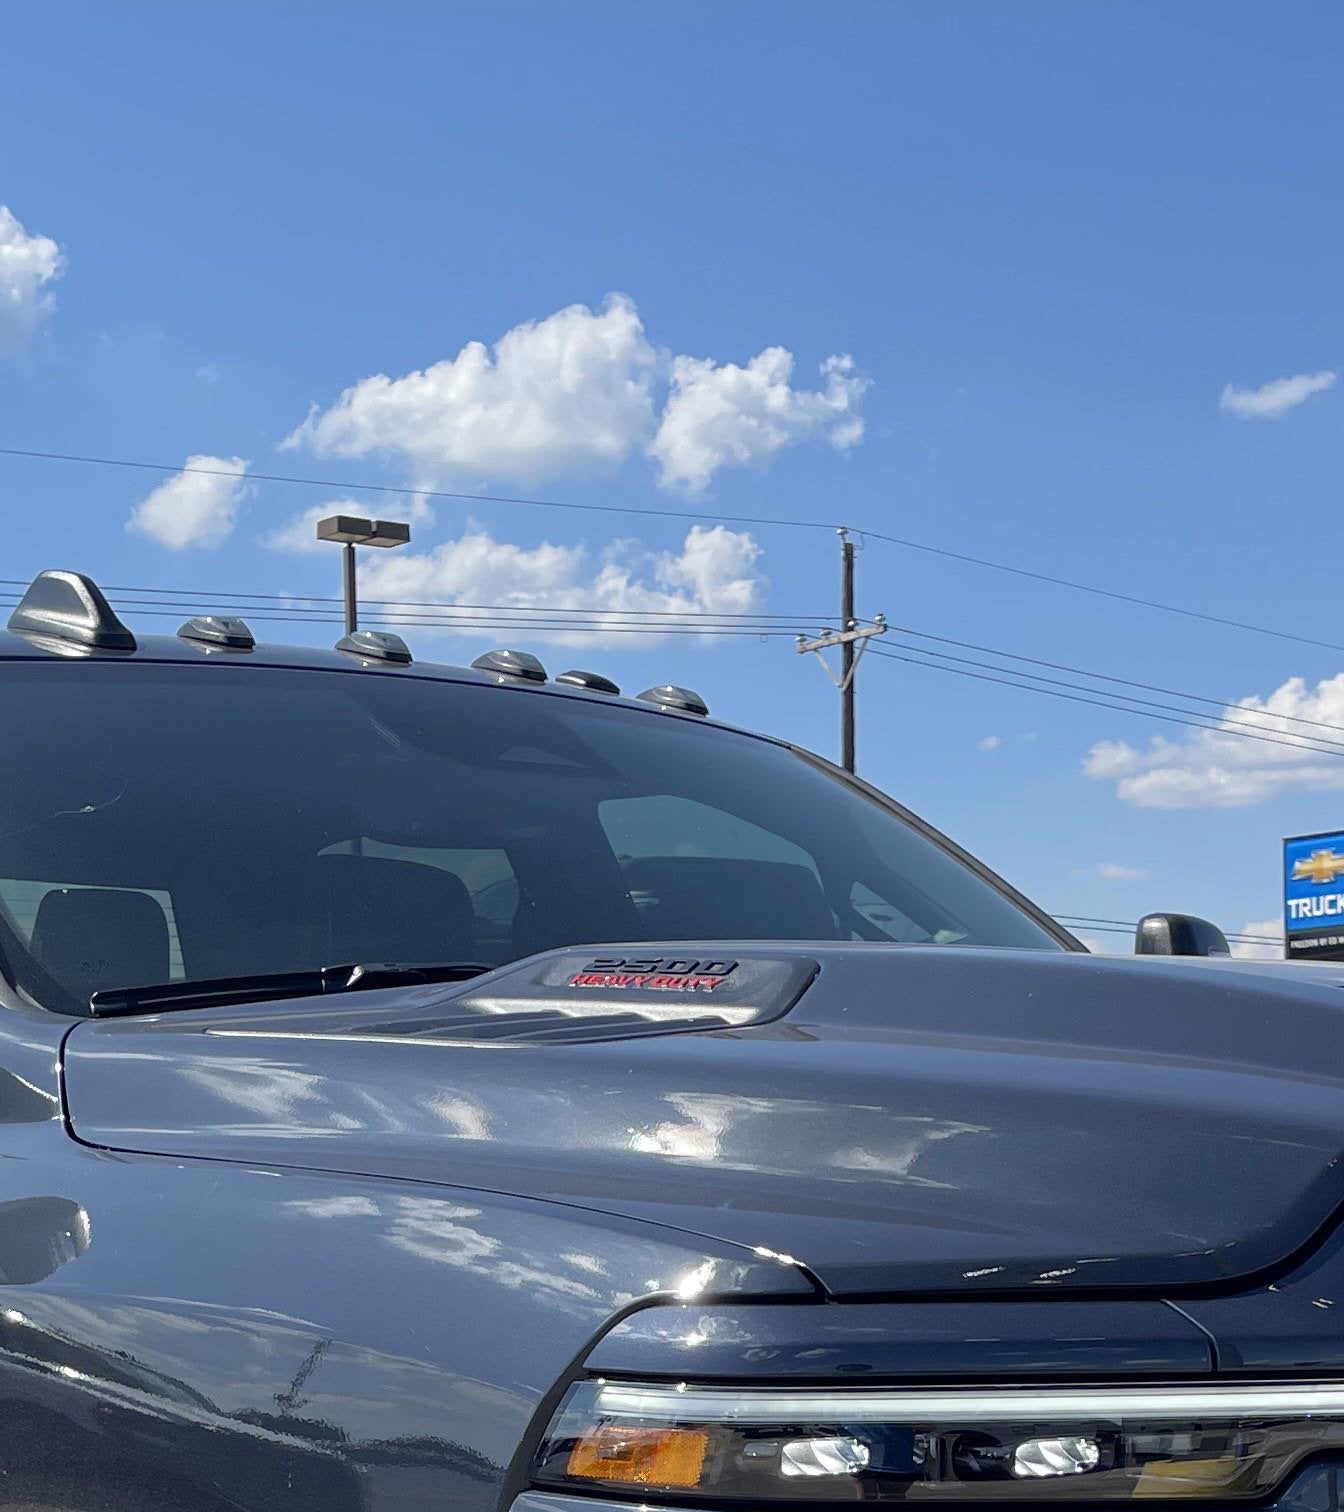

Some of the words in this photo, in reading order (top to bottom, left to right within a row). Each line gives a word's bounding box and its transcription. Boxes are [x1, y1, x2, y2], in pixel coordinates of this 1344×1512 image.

[582, 958, 739, 976] 2500
[568, 973, 651, 988] HEAVY
[648, 975, 725, 992] DUTY
